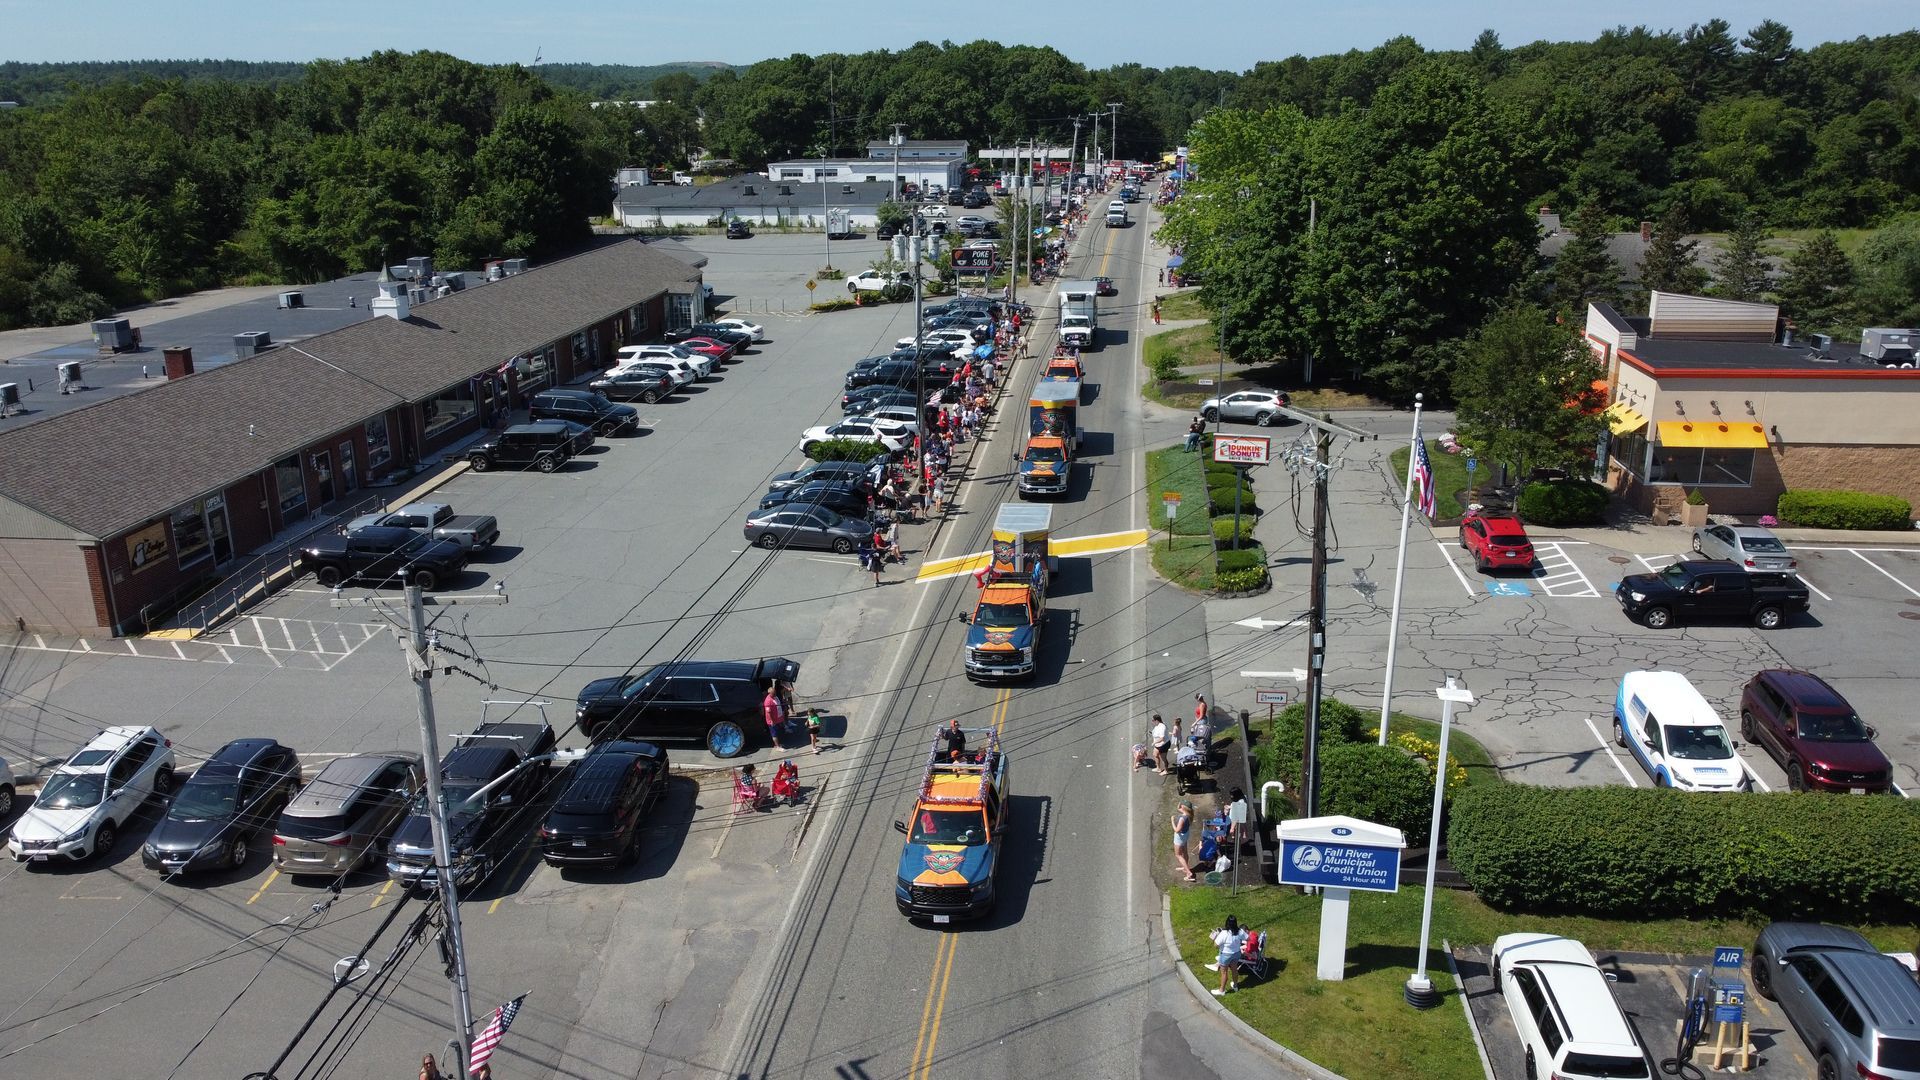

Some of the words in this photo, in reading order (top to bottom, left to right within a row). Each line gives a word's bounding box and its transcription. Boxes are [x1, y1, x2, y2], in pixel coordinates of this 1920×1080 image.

[206, 496, 220, 508] OPEN
[1324, 848, 1343, 857] Fall
[1345, 850, 1373, 859] River
[1324, 856, 1376, 868] Municipal
[1321, 864, 1354, 874] Credit
[1356, 867, 1388, 877] Union
[1717, 952, 1740, 963] AIR
